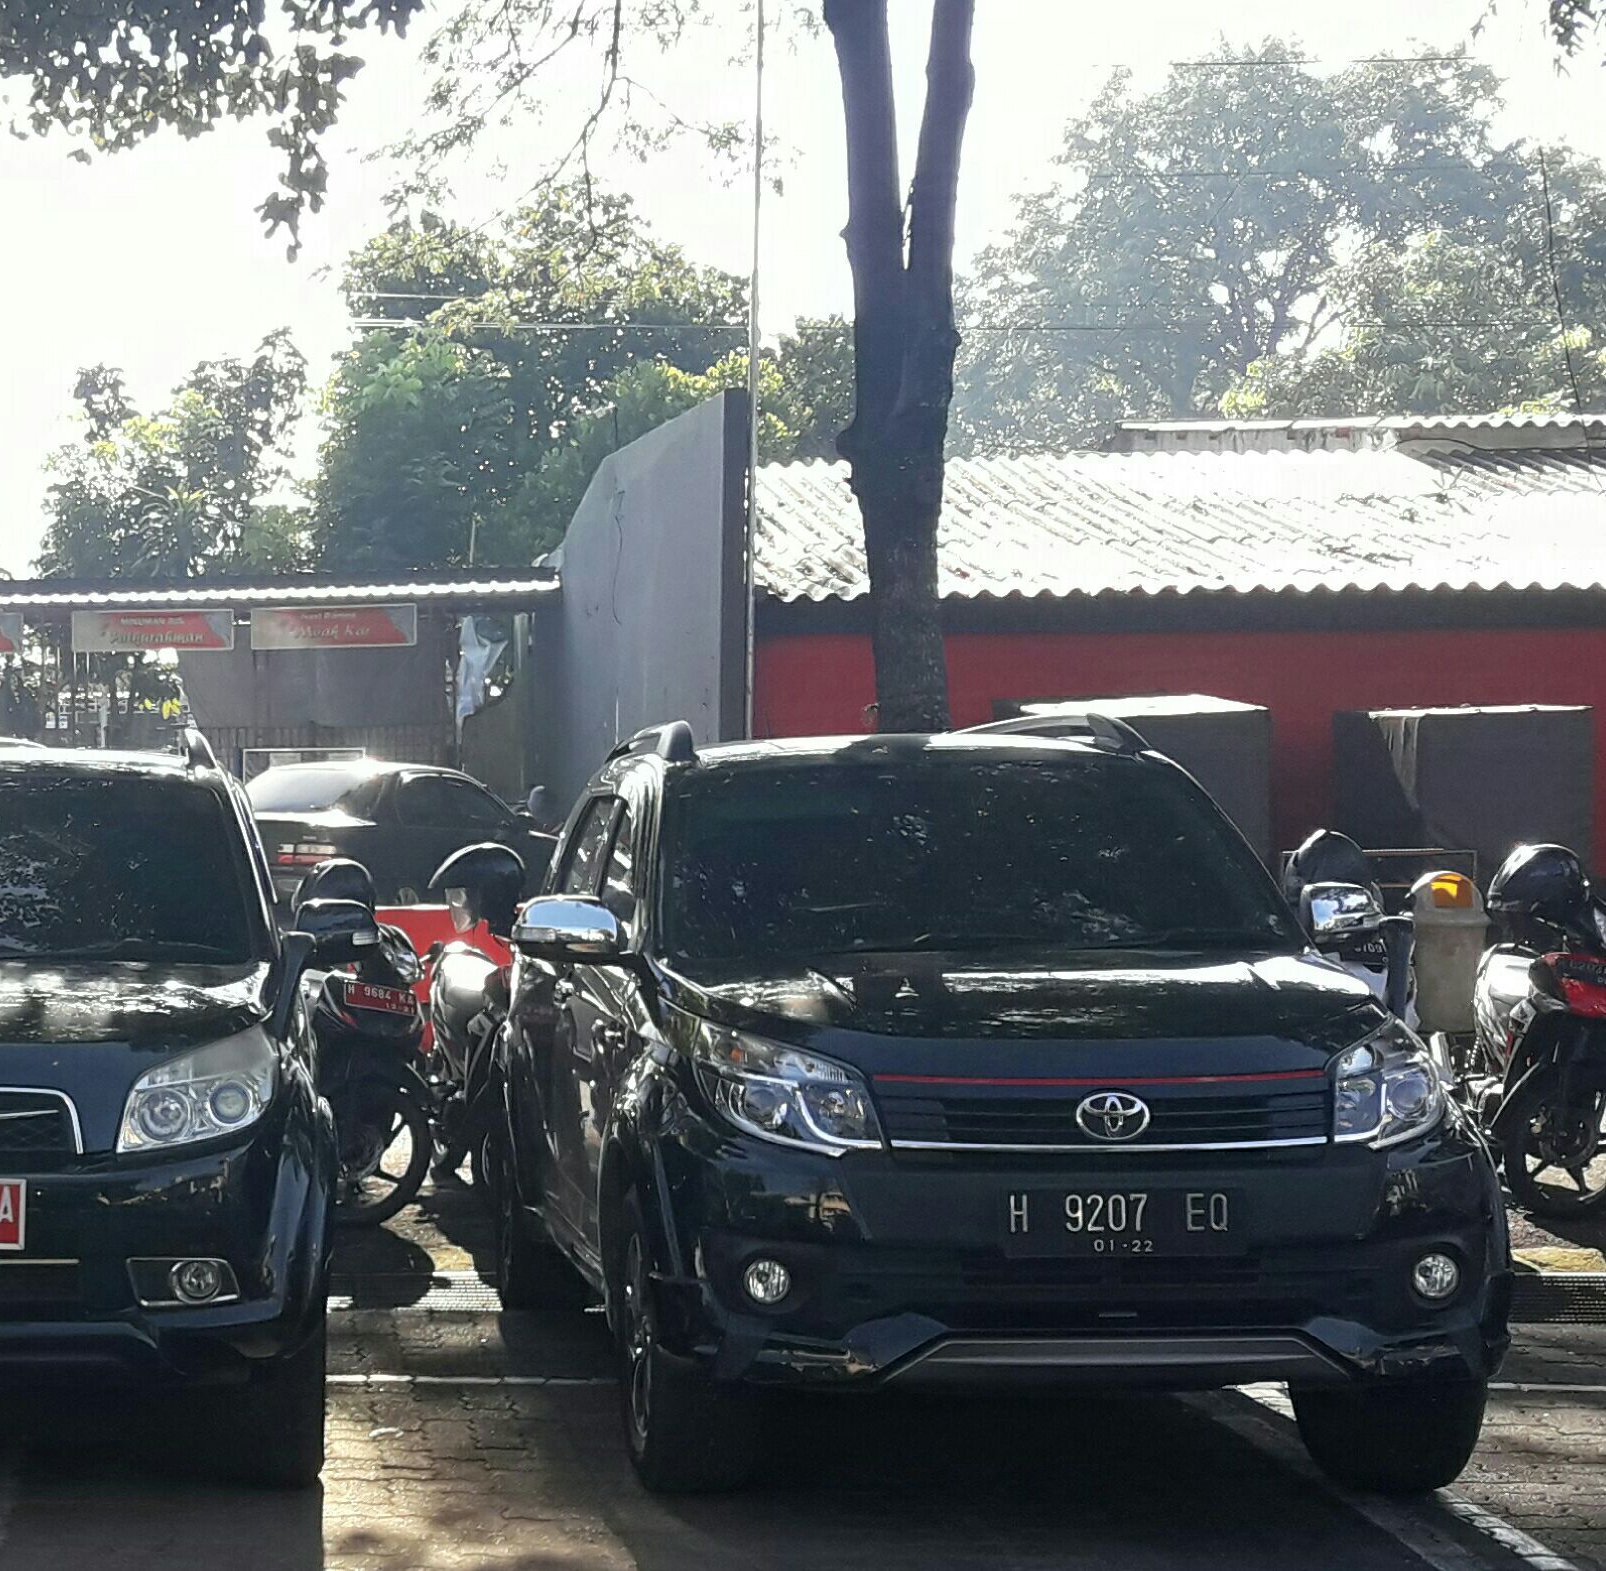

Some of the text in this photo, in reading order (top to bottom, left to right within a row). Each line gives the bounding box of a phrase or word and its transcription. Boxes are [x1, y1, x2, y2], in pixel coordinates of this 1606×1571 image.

[348, 984, 355, 995] H
[1010, 1193, 1228, 1232] H 9207 EQ
